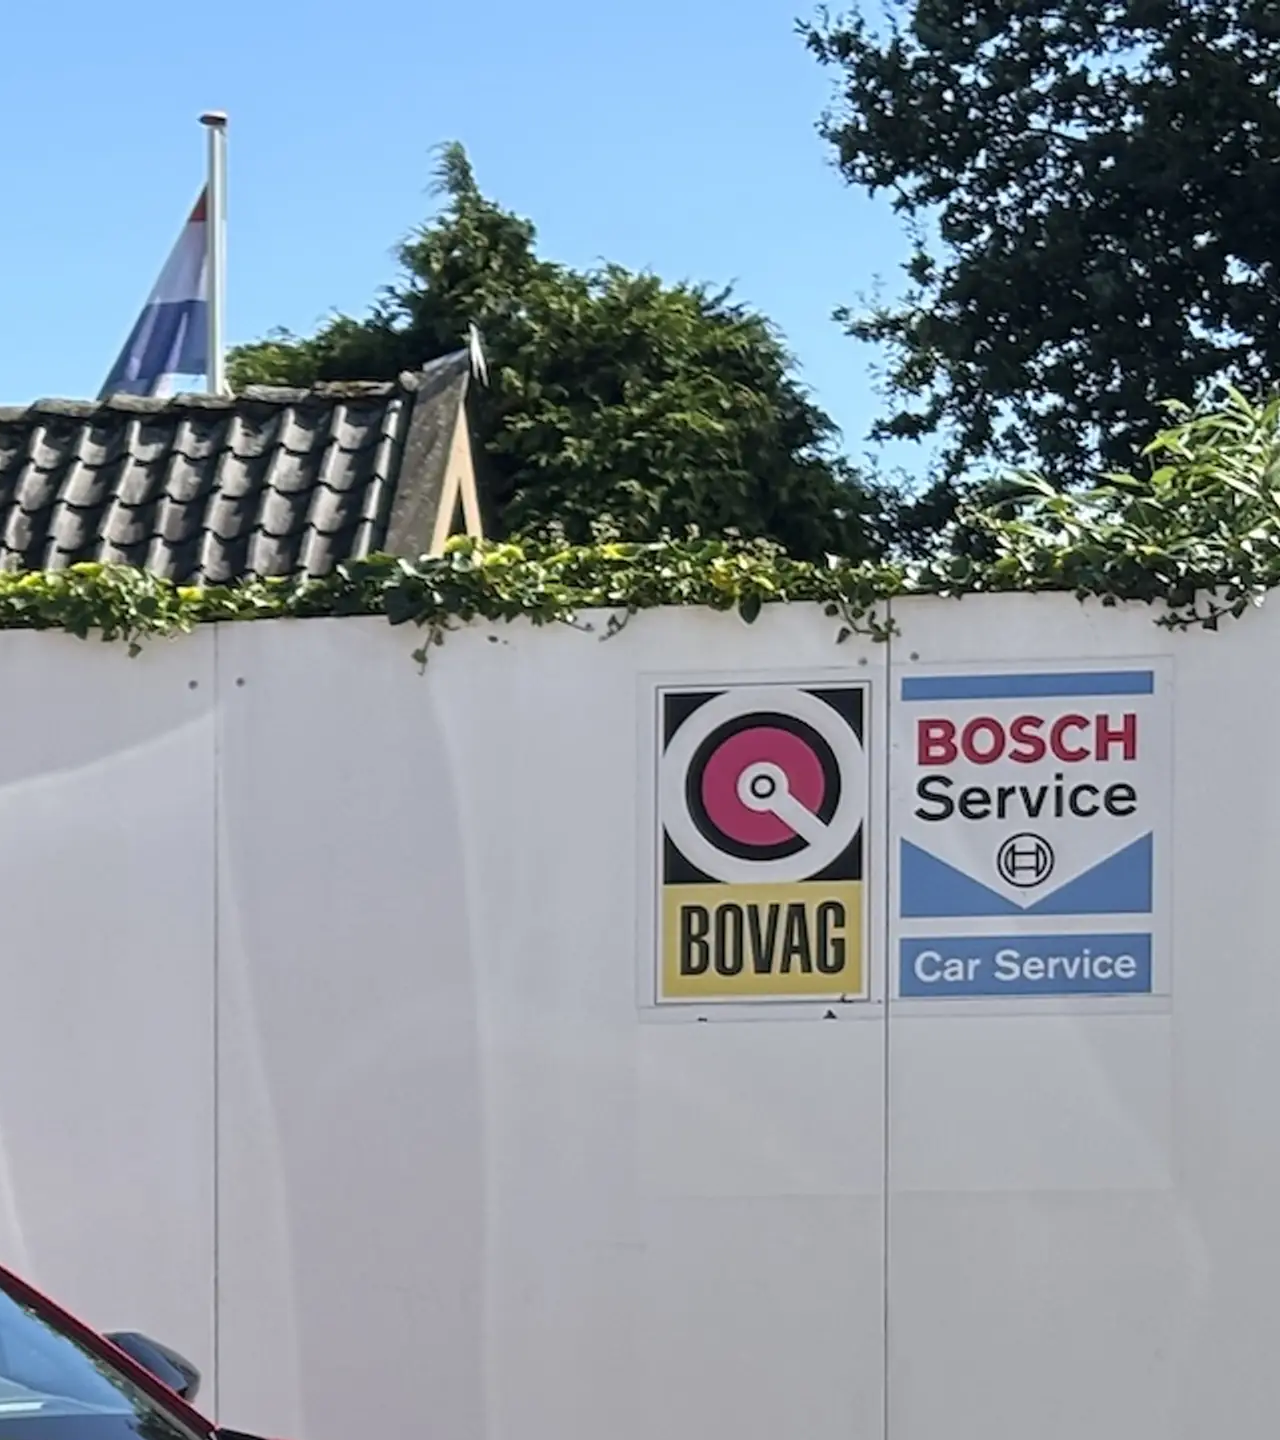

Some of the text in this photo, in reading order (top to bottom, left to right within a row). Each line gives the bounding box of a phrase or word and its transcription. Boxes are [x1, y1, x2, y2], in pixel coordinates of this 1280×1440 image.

[916, 713, 1137, 766] BOSCH
[914, 773, 1138, 822] Service
[679, 901, 846, 977] BOVAG
[914, 948, 1138, 983] Car Service
